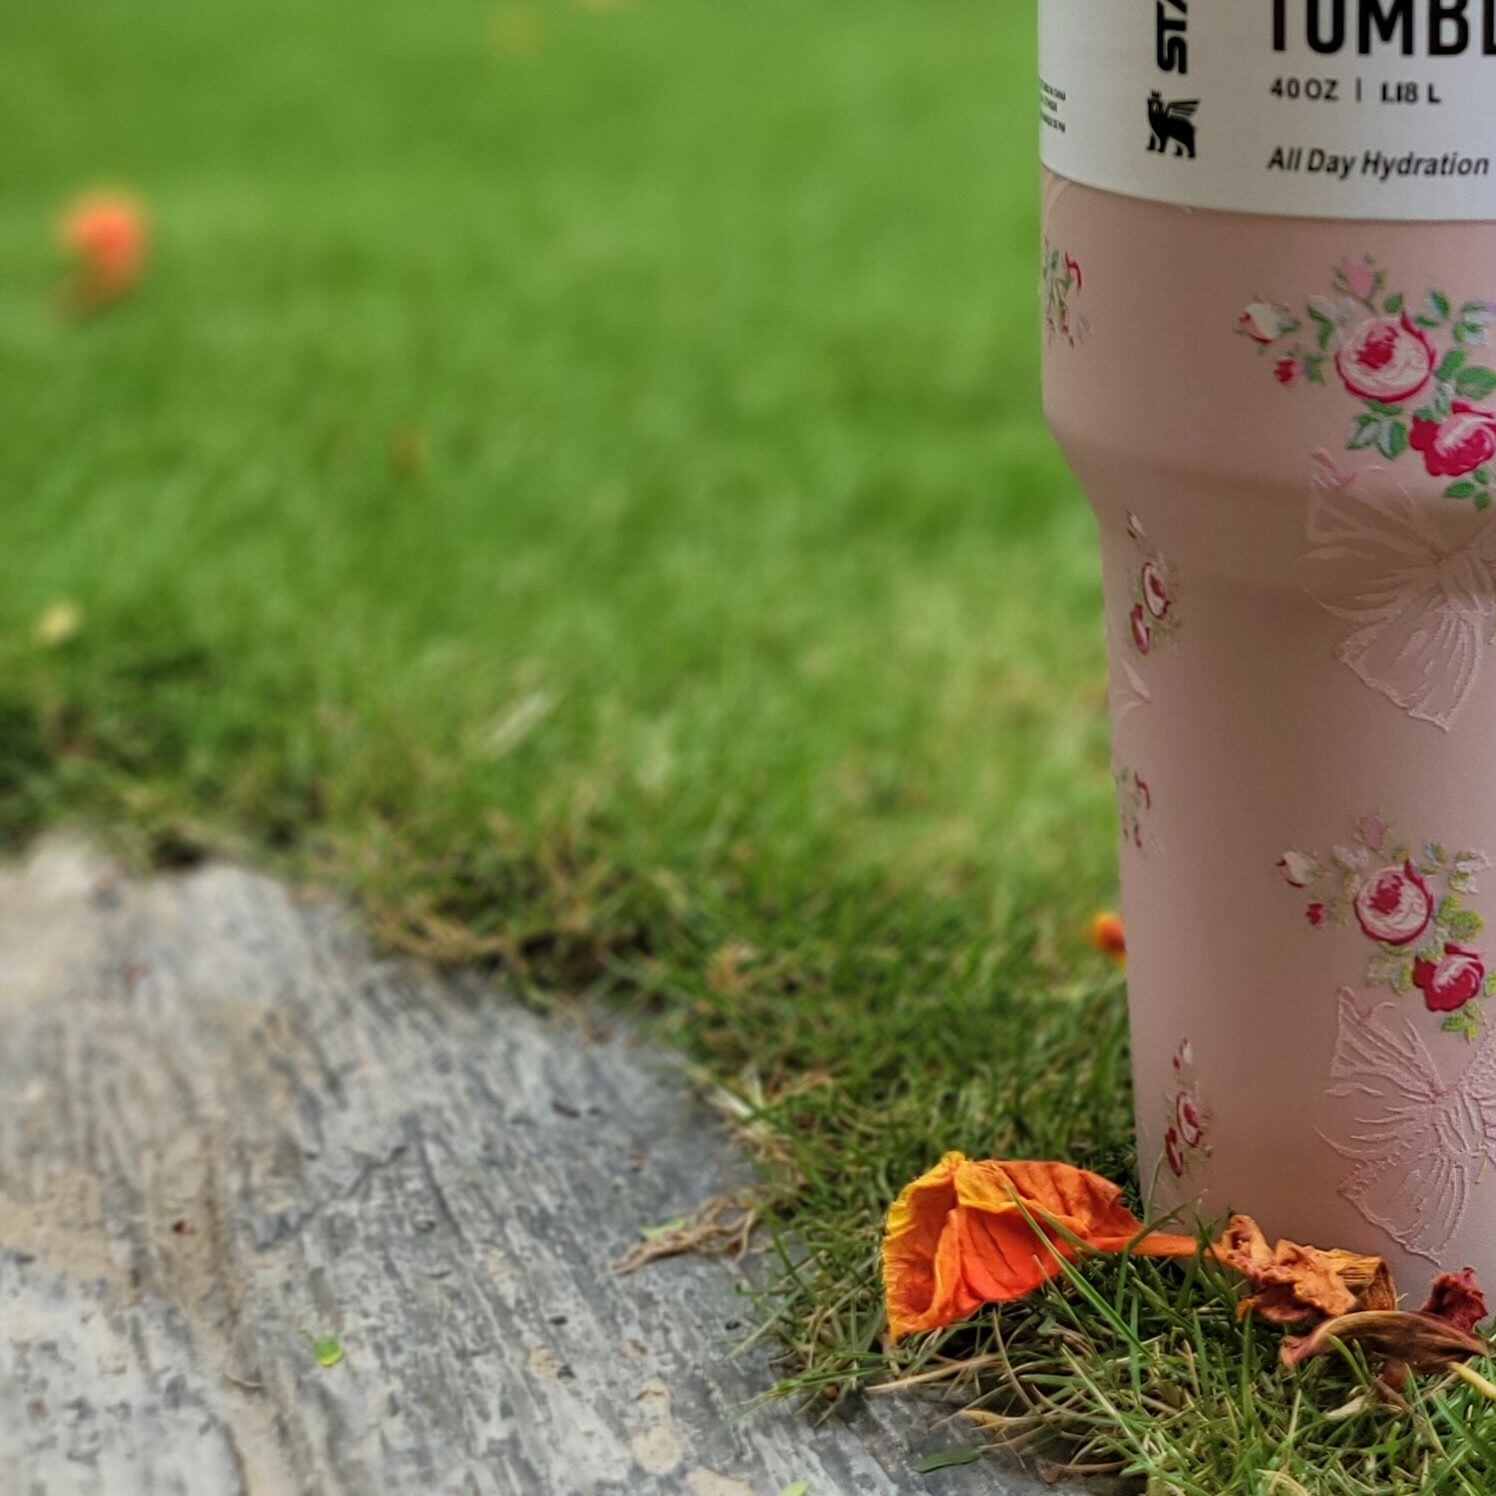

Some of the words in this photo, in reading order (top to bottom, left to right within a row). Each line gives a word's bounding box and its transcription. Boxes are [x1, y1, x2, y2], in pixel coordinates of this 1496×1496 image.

[1267, 147, 1303, 172] All
[1307, 149, 1355, 180] Day
[1360, 151, 1490, 182] Hydration
